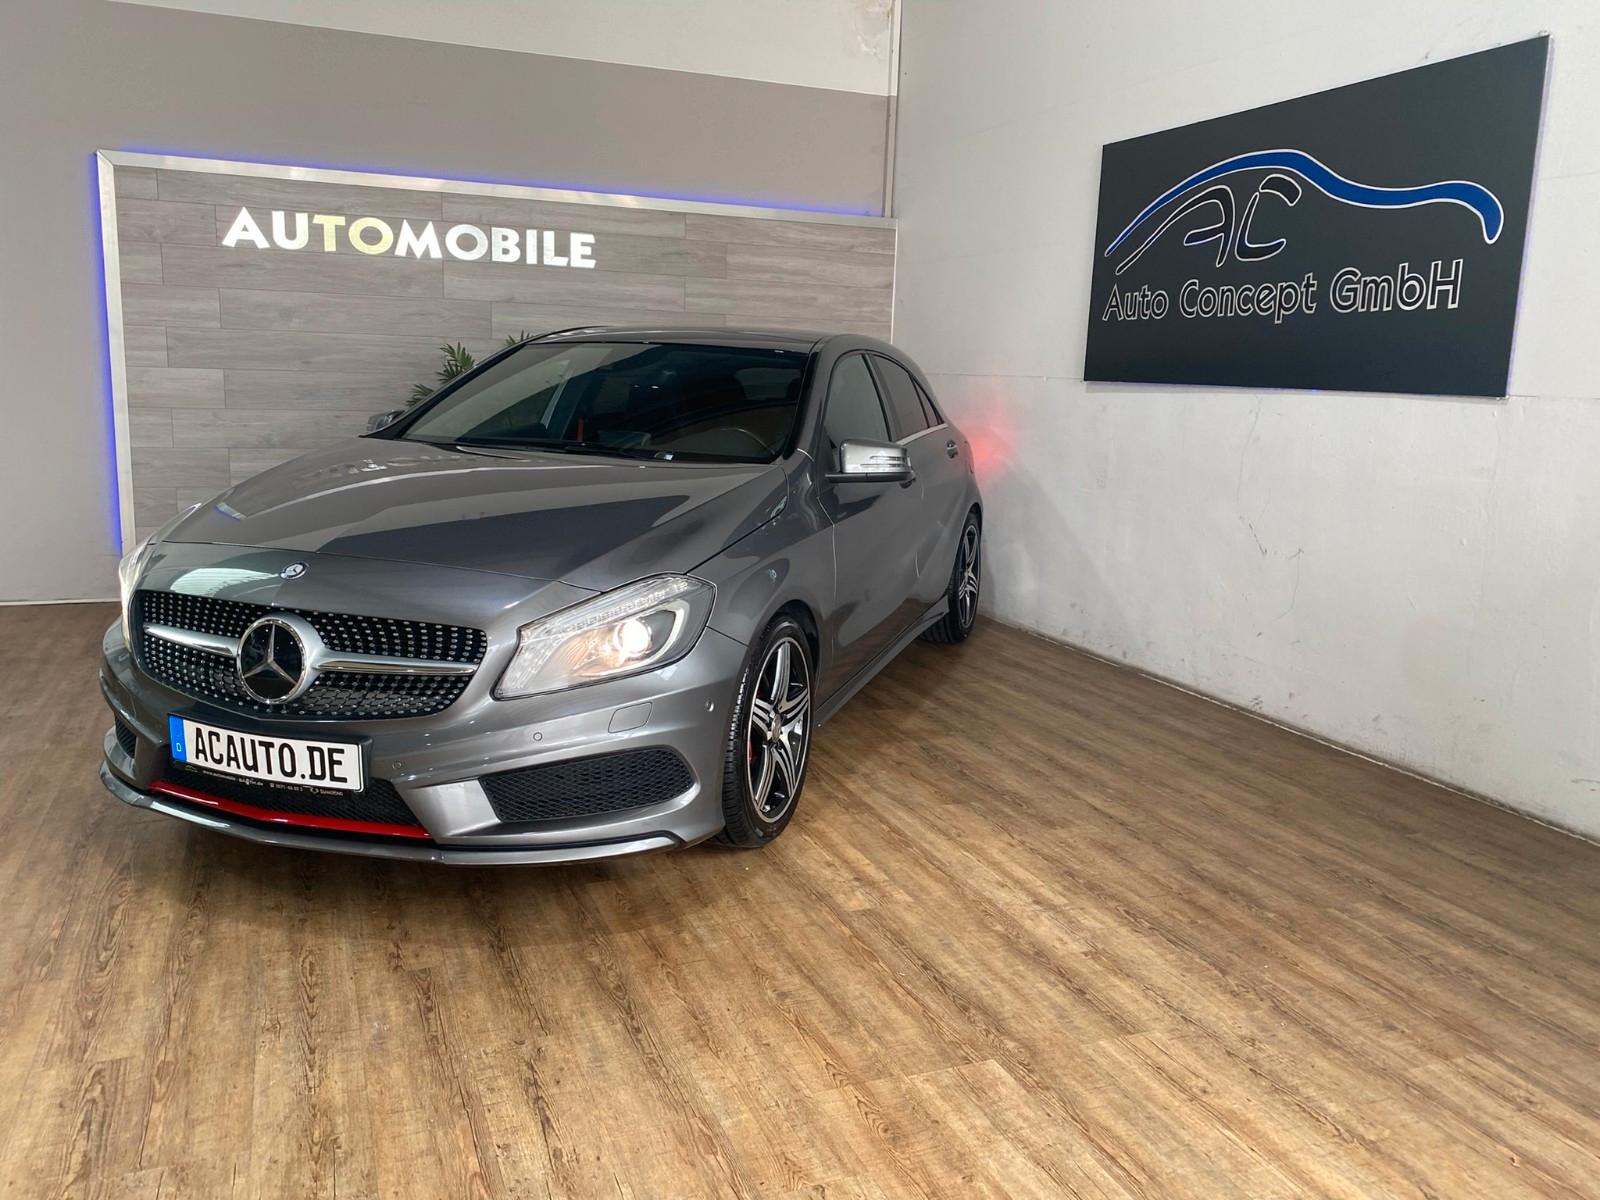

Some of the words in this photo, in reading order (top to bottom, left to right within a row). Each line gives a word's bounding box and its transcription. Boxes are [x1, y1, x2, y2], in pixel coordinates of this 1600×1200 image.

[222, 207, 597, 269] AUTOMOBILE
[1115, 174, 1302, 275] AC
[1103, 284, 1169, 321] Auto
[1179, 273, 1318, 324] Concept
[1330, 259, 1463, 313] GmbH
[195, 727, 347, 783] ACAUTO.DE
